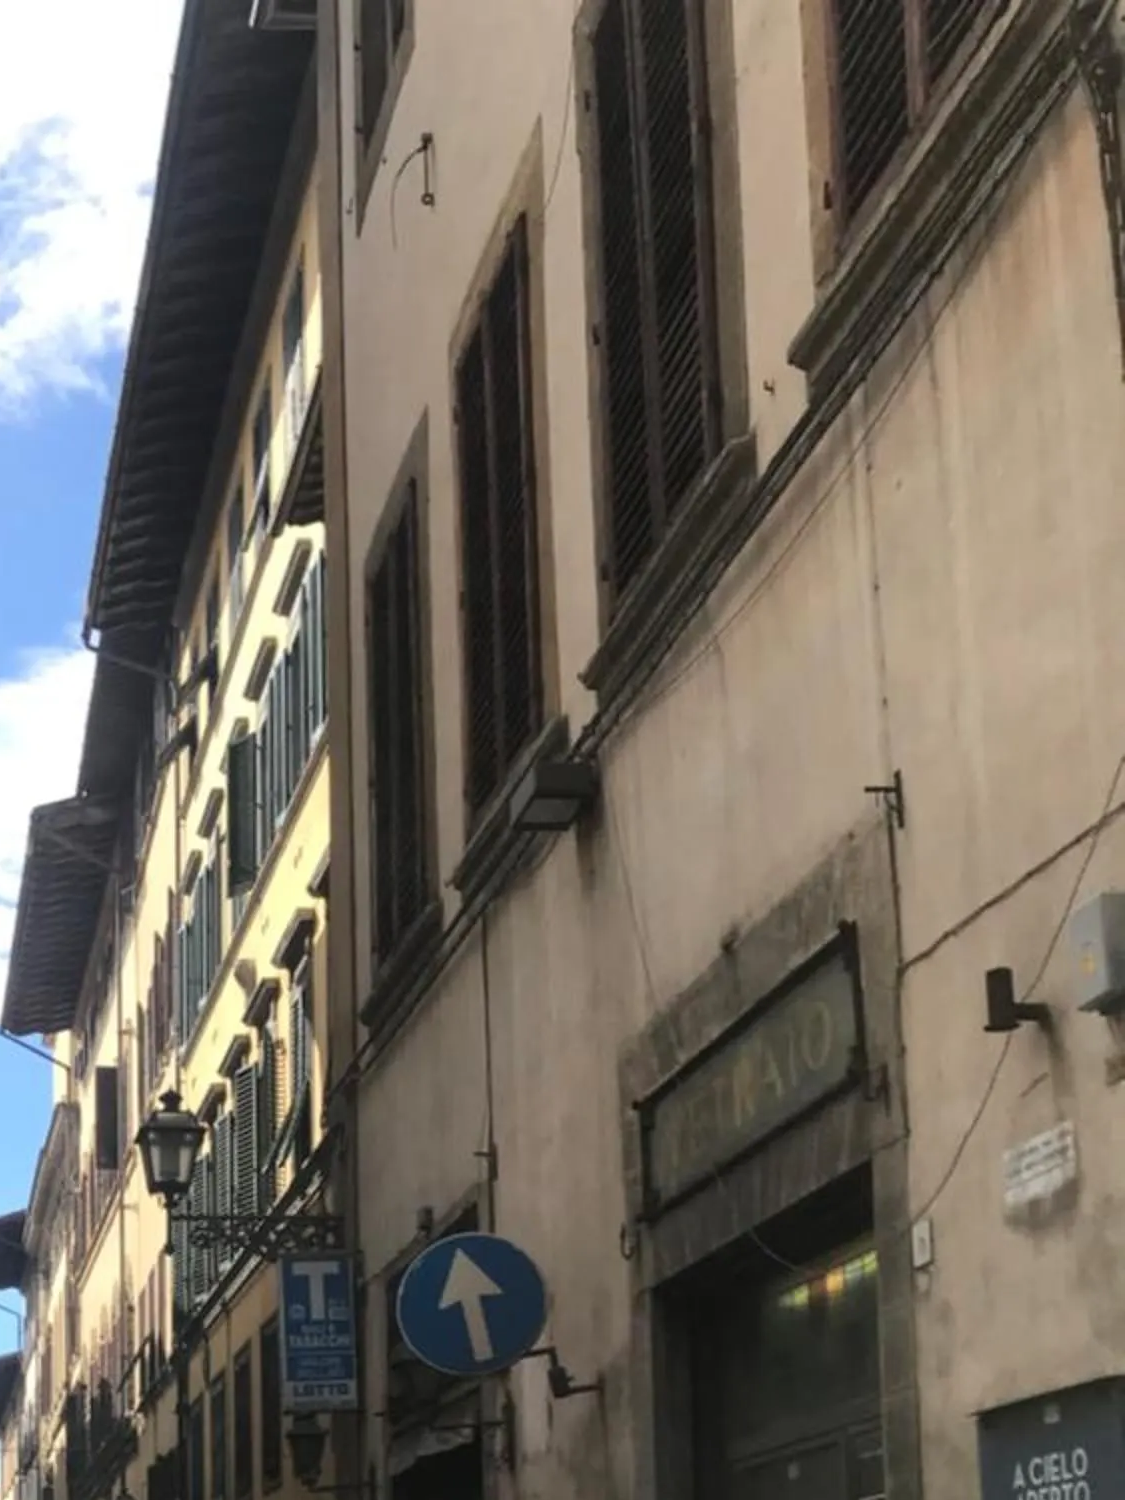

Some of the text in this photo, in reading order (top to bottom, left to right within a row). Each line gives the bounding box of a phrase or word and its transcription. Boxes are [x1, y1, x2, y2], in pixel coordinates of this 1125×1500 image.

[291, 1261, 341, 1320] T
[293, 1383, 350, 1398] LOTTO
[1013, 1447, 1089, 1489] A CIELO
